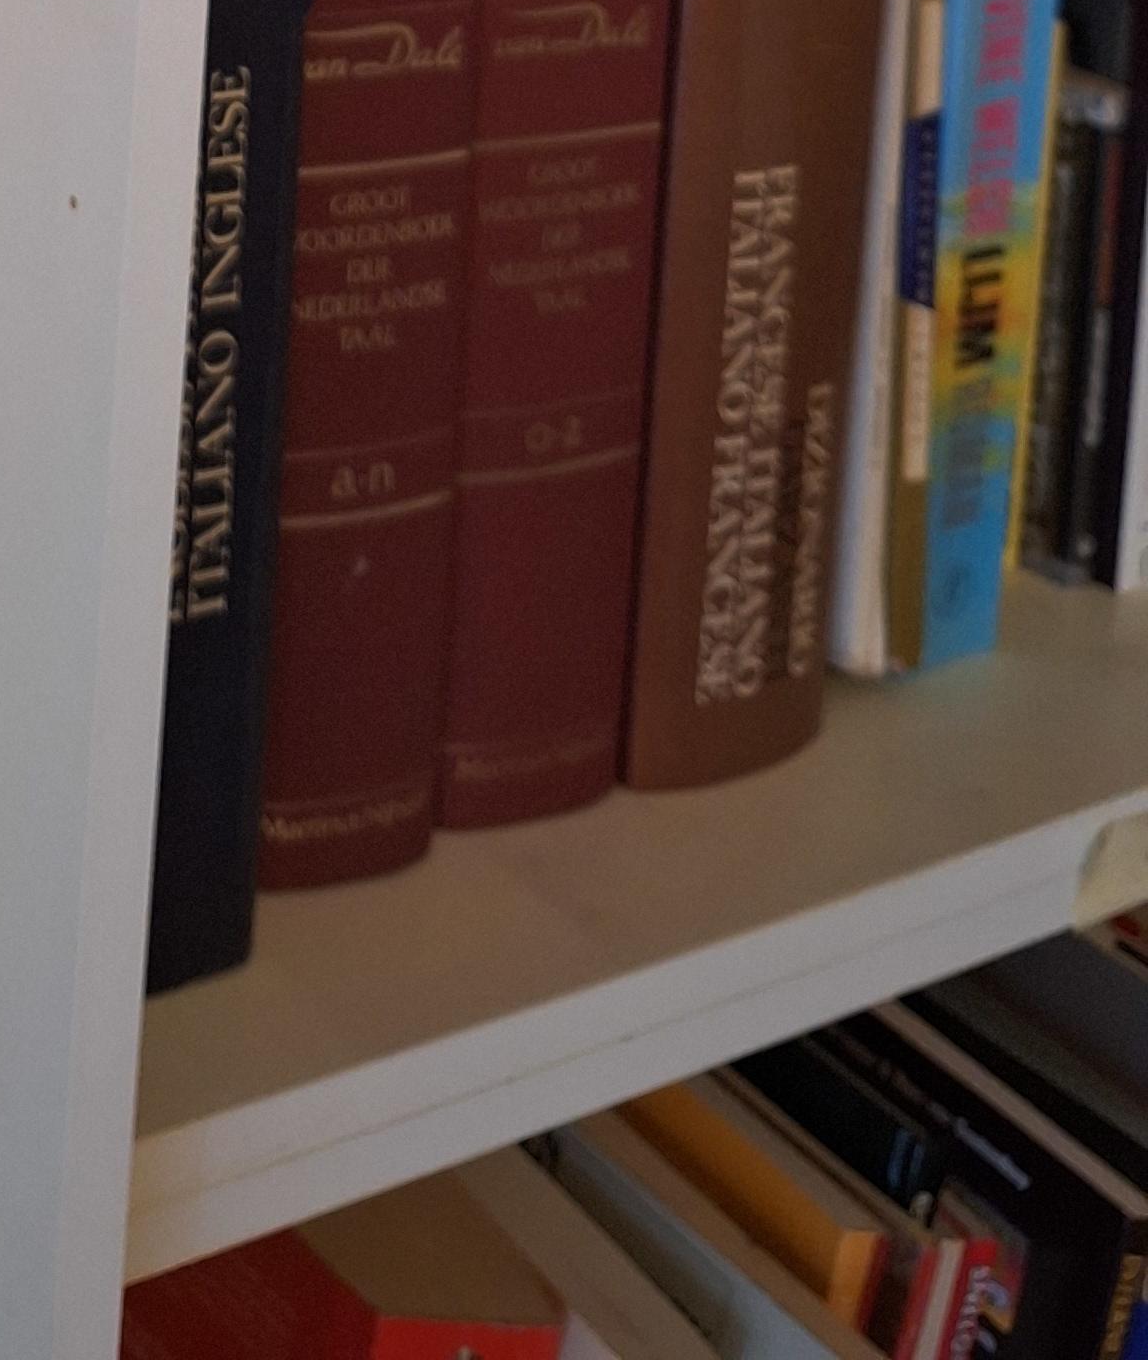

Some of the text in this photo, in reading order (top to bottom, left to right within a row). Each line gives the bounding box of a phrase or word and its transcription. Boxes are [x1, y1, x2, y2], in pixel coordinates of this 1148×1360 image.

[186, 62, 252, 620] ITALIANO INGLESE
[693, 170, 766, 708] ITALIANO FRANCESE
[731, 164, 799, 698] FRANCESE ITALIANO
